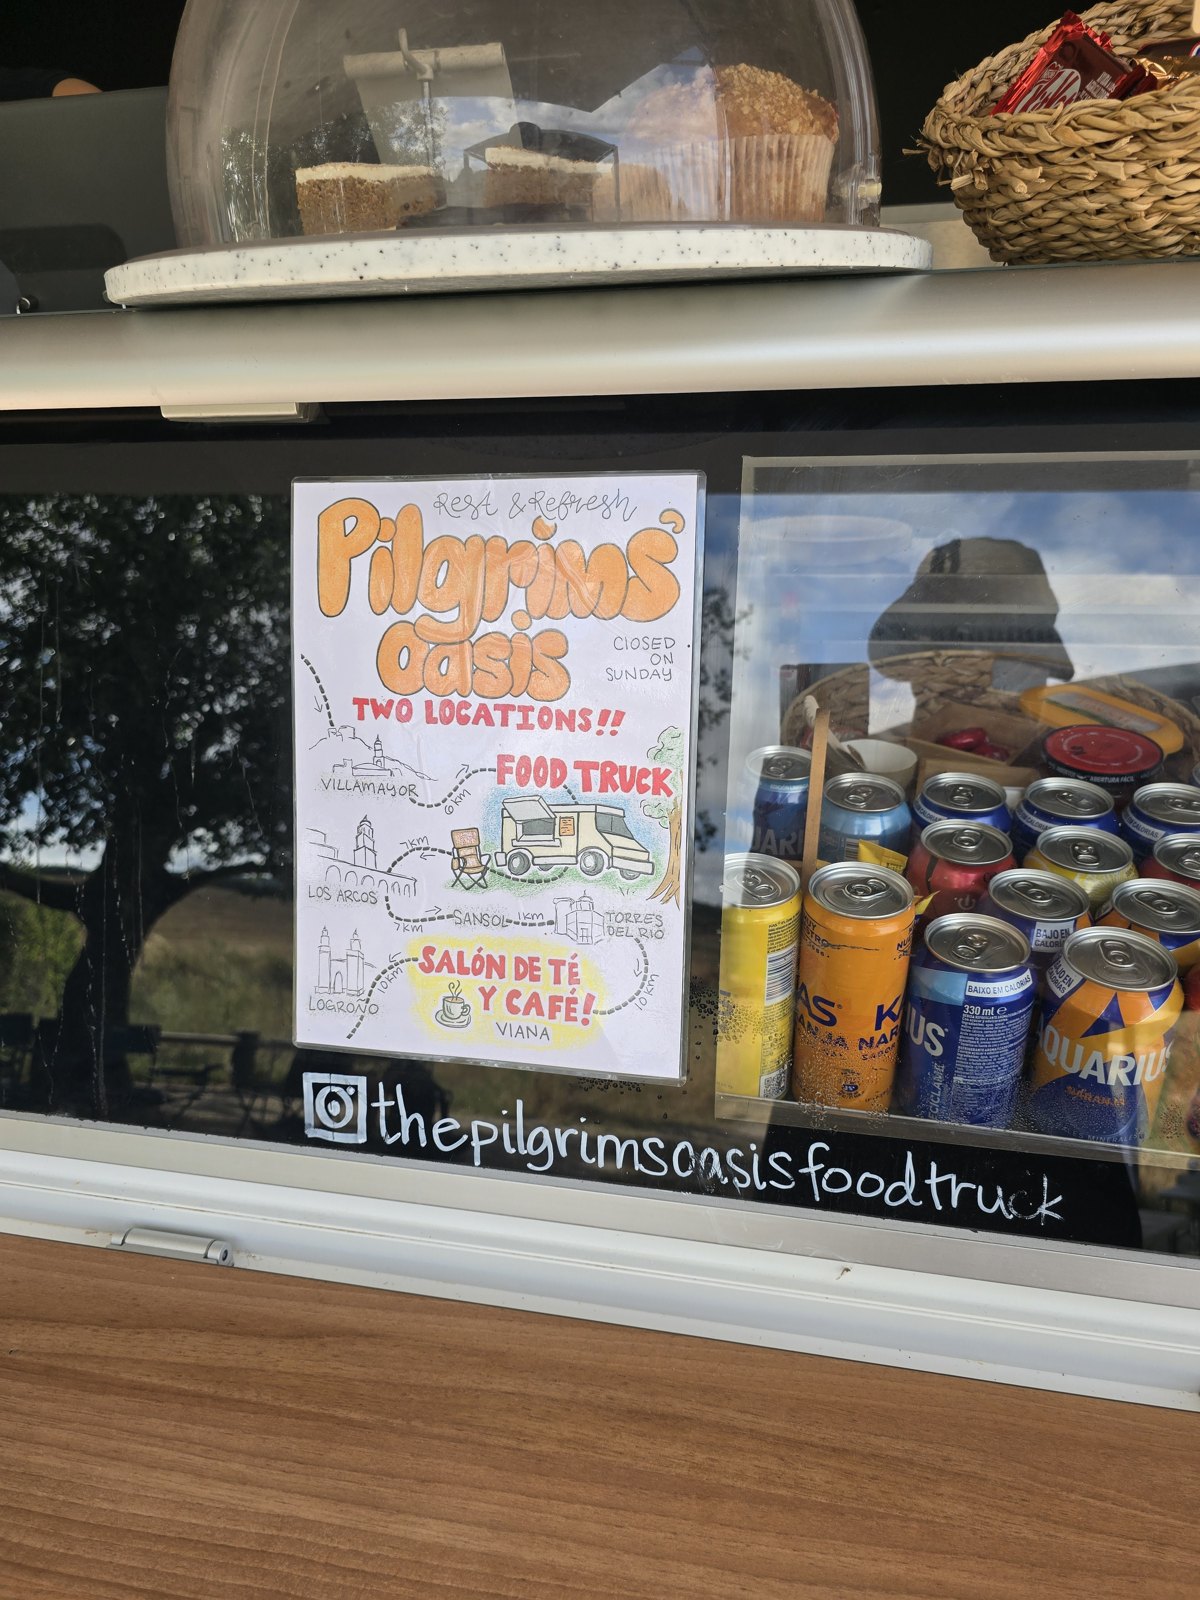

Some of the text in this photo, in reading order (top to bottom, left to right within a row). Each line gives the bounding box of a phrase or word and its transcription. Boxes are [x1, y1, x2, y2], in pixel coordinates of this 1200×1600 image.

[433, 488, 637, 522] Rest & Refresh
[650, 652, 674, 666] ON
[605, 667, 672, 682] SUNDAY
[352, 696, 626, 737] TWO LOCATIONS!!
[496, 753, 674, 798] FOOD TRUCK
[320, 778, 419, 798] VILLAMAYOR
[308, 885, 378, 905] LOS ARCOS
[453, 909, 508, 928] SANSOL
[606, 911, 664, 928] TORRES
[606, 925, 634, 938] DEL
[1035, 928, 1070, 939] BAJO EN
[417, 945, 581, 986] SALÓN DE TÉ
[968, 974, 1031, 994] BAIXO EM CALORIAS
[1063, 974, 1074, 988] EN
[308, 995, 379, 1014] LOGROÑO
[478, 985, 597, 1027] Y CAFÉ!
[797, 982, 837, 1027] AS
[963, 1004, 981, 1016] 330
[982, 1006, 995, 1016] ml
[496, 1022, 550, 1041] VIANA
